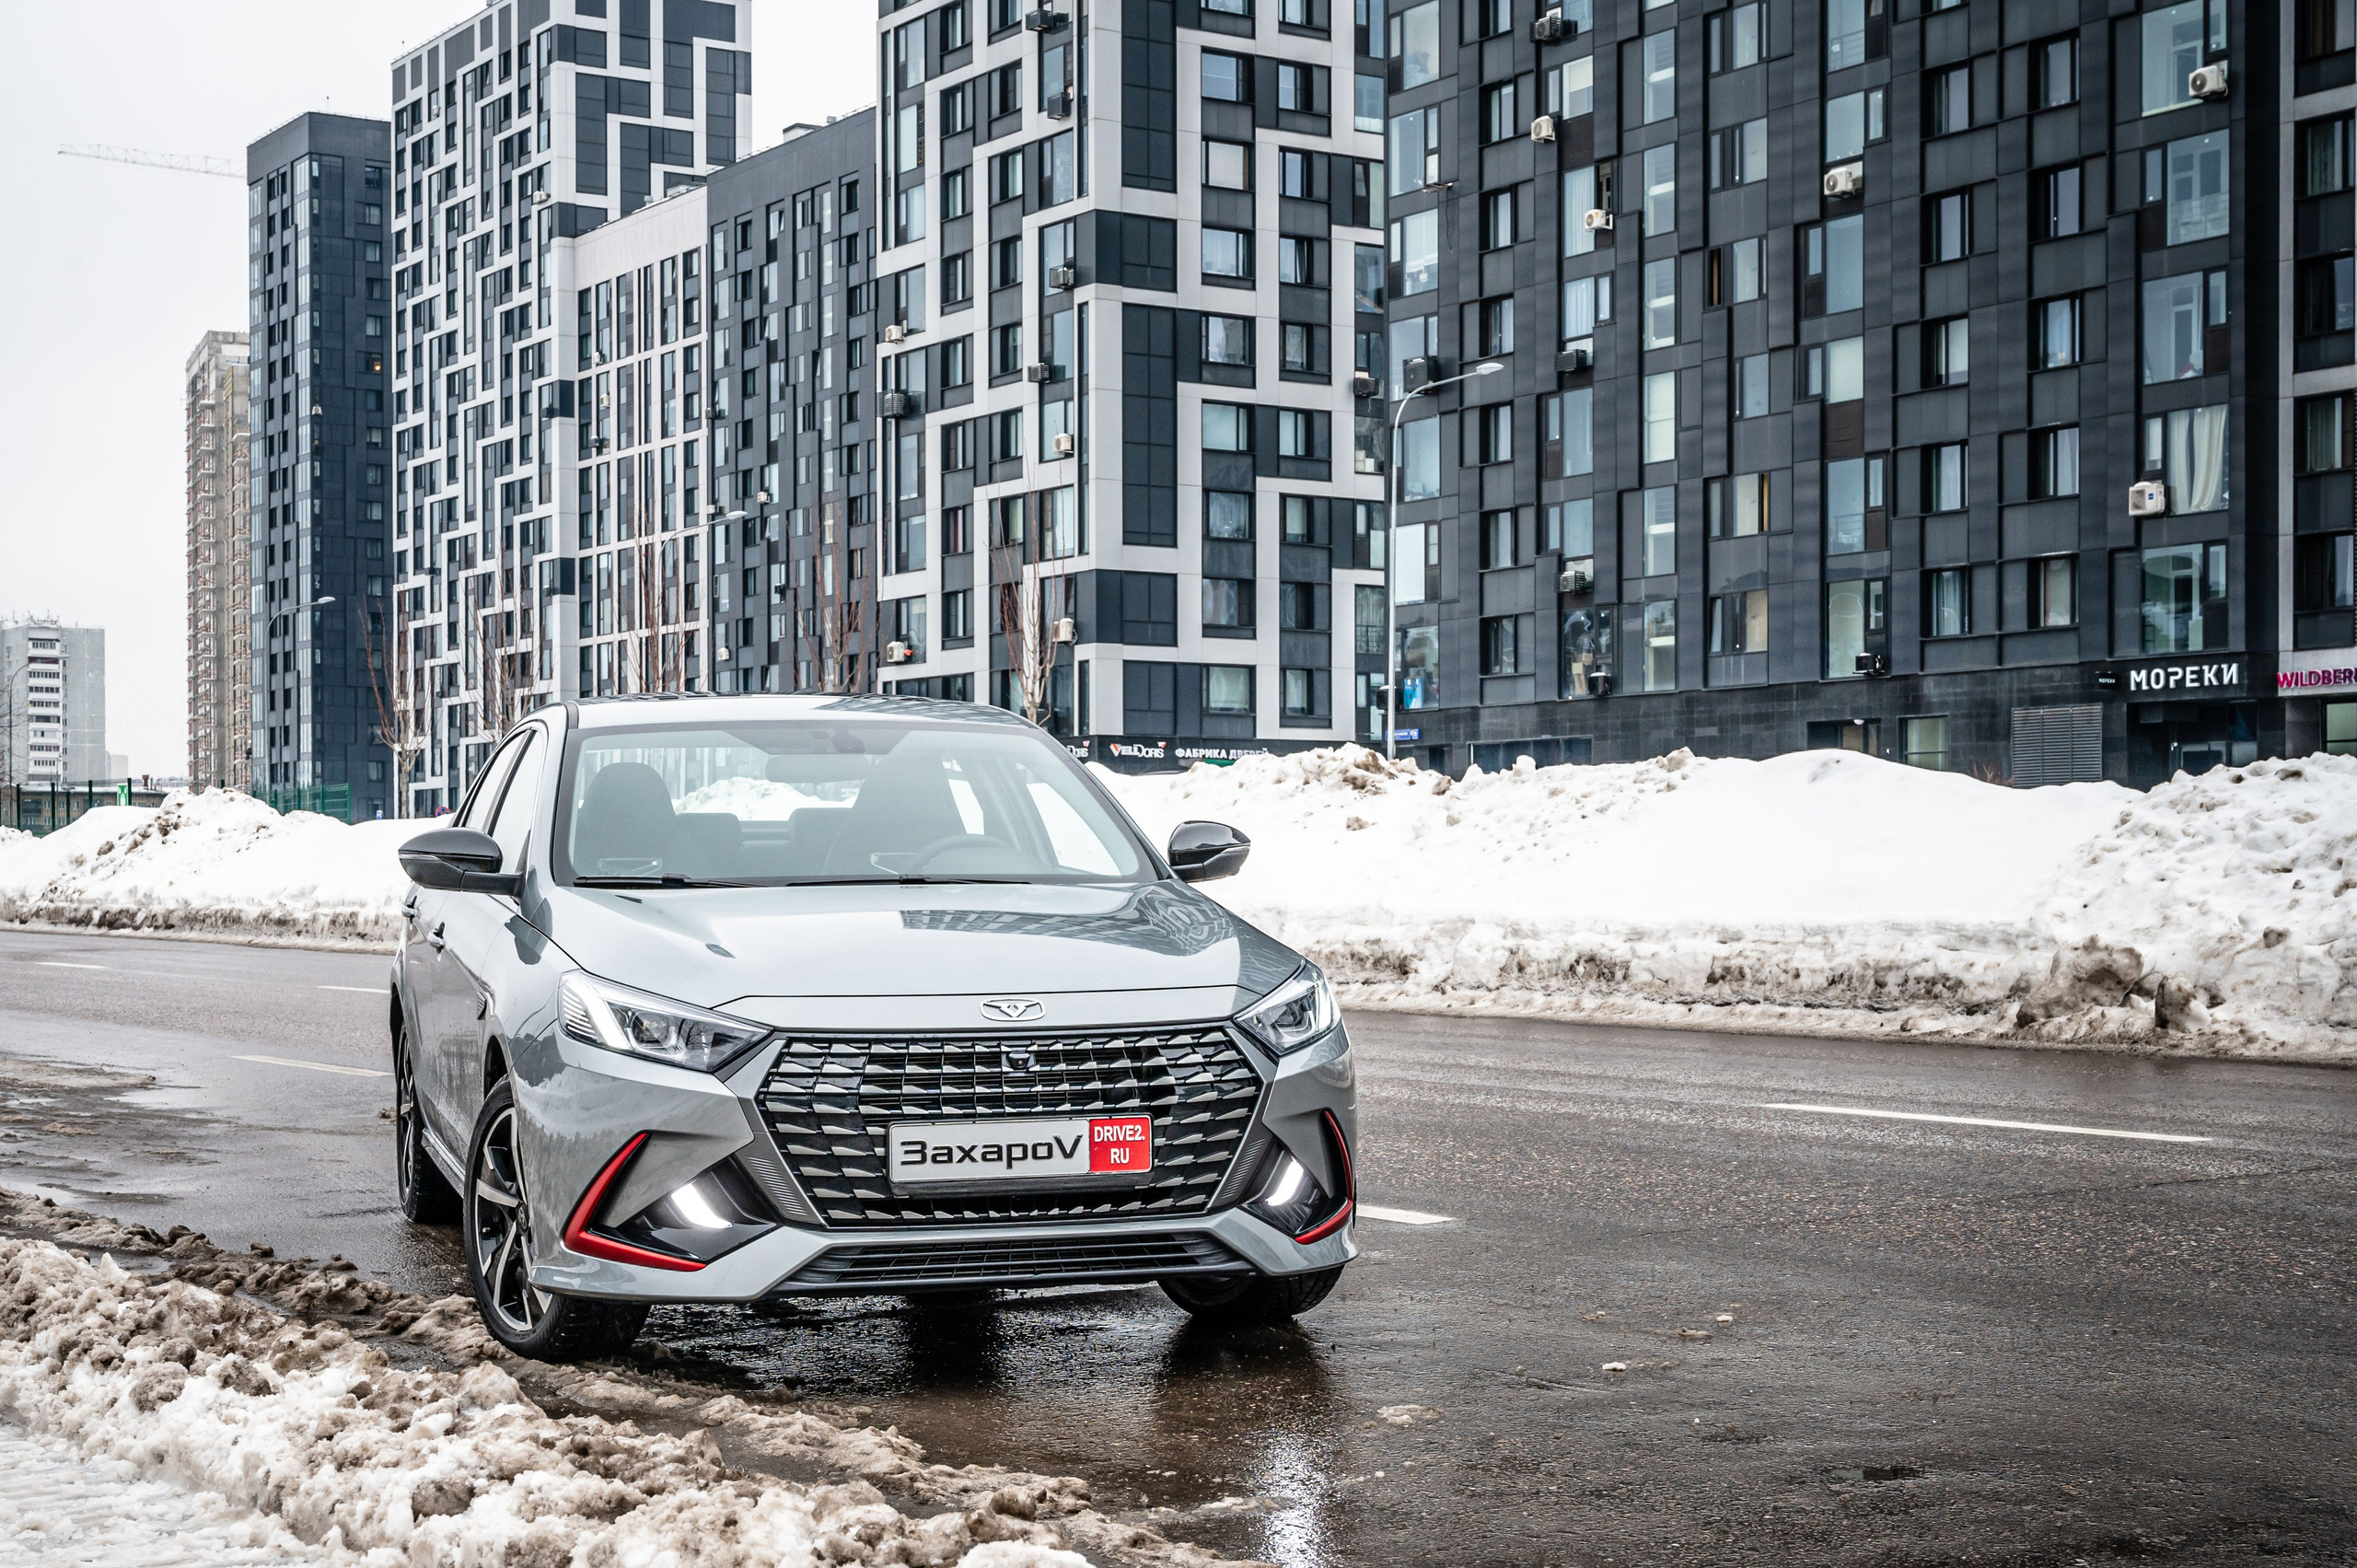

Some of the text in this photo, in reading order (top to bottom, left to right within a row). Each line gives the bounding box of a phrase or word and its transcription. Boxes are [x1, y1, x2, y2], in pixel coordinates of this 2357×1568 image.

[2130, 663, 2239, 691] МОРЕКИ
[2276, 668, 2357, 689] WILDBER
[1175, 748, 1227, 759] ФАБРИКА
[1094, 1124, 1145, 1143] DRIVE2.
[1110, 1147, 1131, 1165] RU
